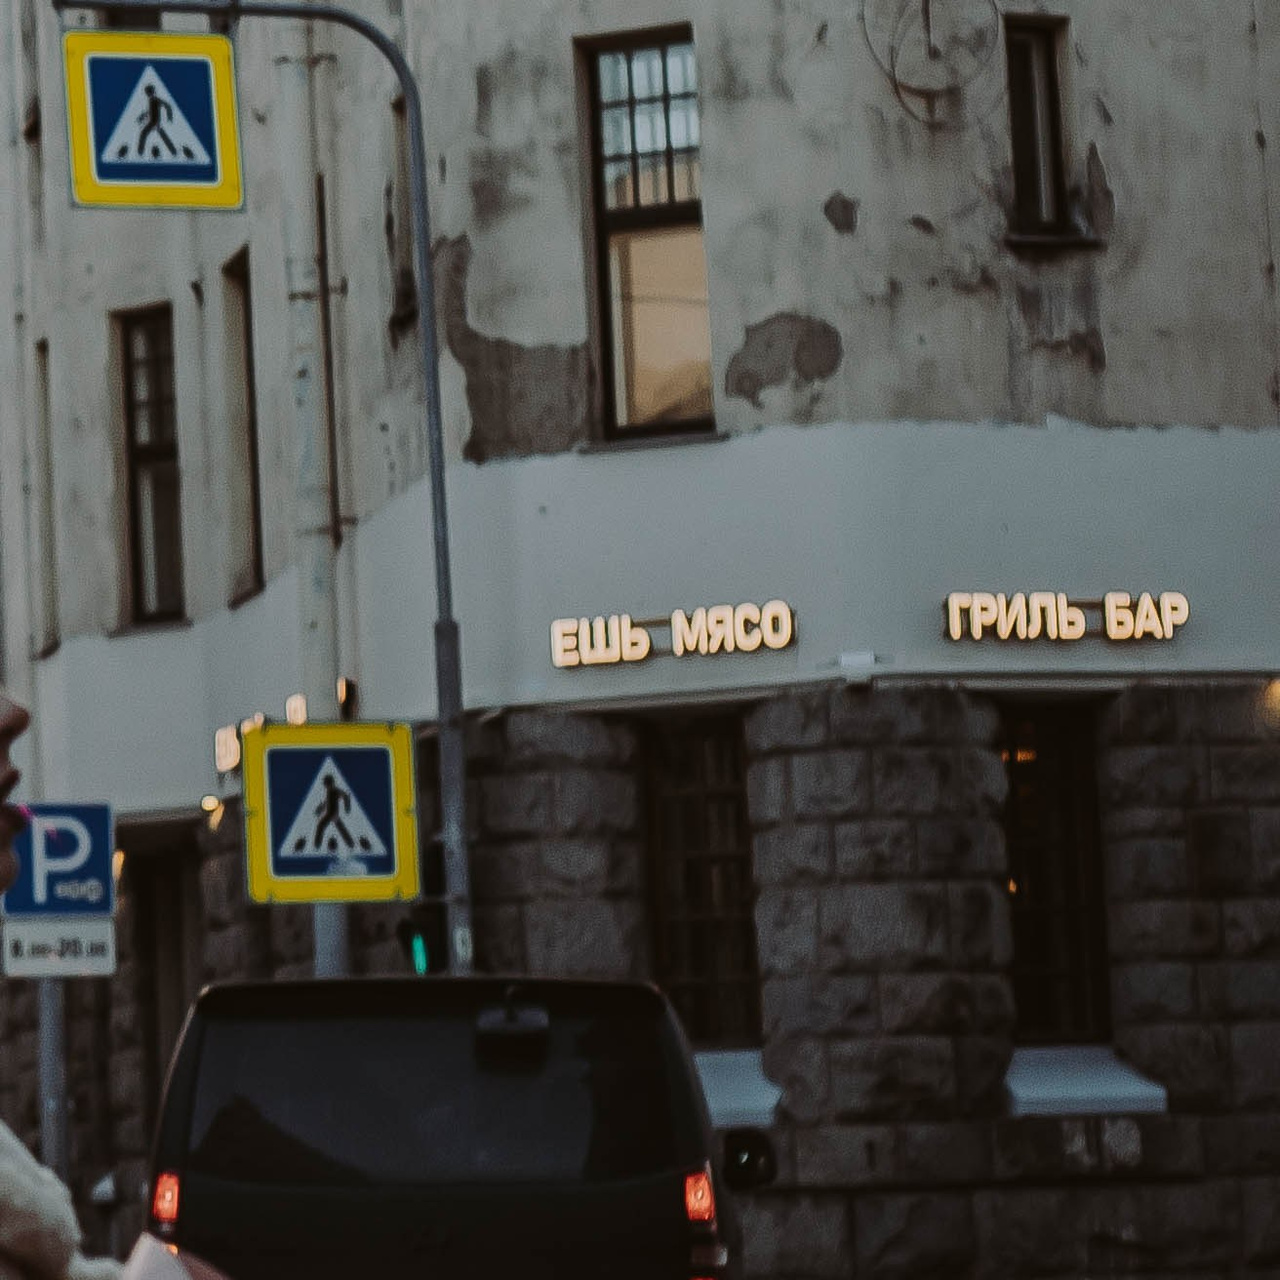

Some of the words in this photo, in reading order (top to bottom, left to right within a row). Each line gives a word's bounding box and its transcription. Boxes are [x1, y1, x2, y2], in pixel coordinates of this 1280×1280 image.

[551, 615, 651, 667] ЕШЬ
[671, 600, 793, 656] МЯСО
[948, 591, 1086, 641] ГРИЛЬ
[1104, 591, 1190, 640] БАР
[32, 815, 92, 904] P
